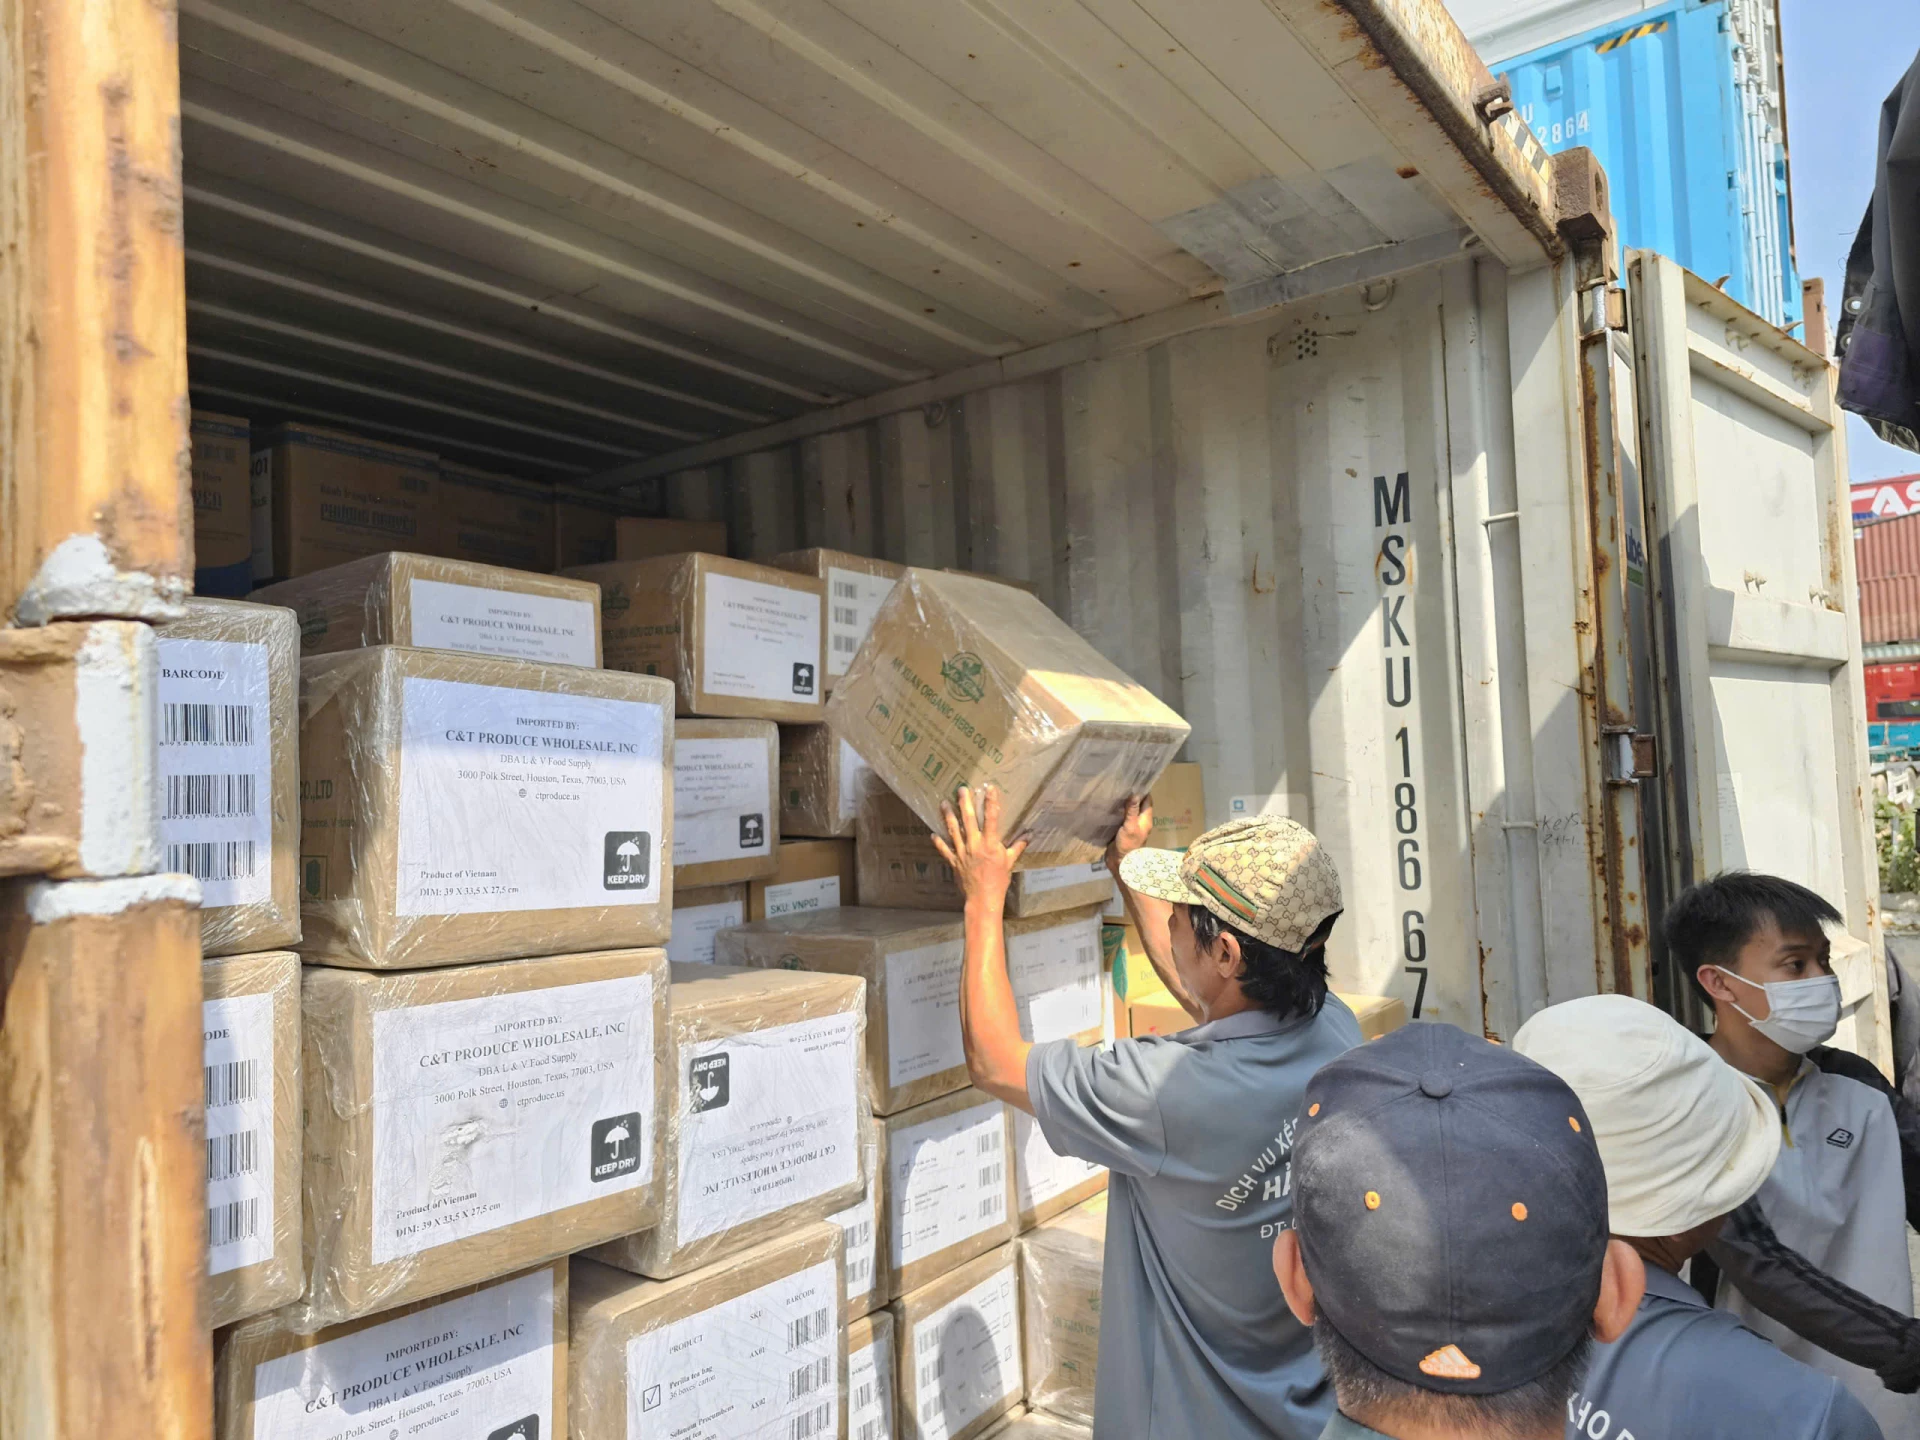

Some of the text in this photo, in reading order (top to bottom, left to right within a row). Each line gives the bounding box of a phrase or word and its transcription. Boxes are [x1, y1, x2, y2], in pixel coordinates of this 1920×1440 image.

[1373, 471, 1413, 708] MSKU
[440, 615, 460, 624] C&T
[463, 617, 504, 629] PRODUCE
[562, 628, 576, 636] INC
[162, 668, 224, 680] BARCODE
[921, 684, 954, 719] ORGANIC
[954, 714, 975, 738] HERB
[516, 717, 579, 730] IMPORTED BY:
[446, 729, 638, 754] C&T PRODUCE WHOLESALE, INC
[500, 754, 592, 769] DBA L & V Food Supply
[458, 771, 478, 780] 3000
[480, 771, 498, 781] Polk
[500, 772, 524, 782] Street,
[526, 773, 559, 784] Houston,
[562, 775, 584, 785] Texas,
[610, 776, 627, 786] USA
[535, 791, 580, 801] ctproduce.us
[420, 869, 497, 879] Product of Vietnam
[607, 874, 646, 884] KEEP DRY
[420, 887, 442, 896] DIM:
[444, 887, 454, 895] 39
[508, 886, 519, 894] cm
[494, 1015, 562, 1034] IMPORTED BY:
[419, 1022, 626, 1068] C&T PRODUCE WHOLESALE, INC
[478, 1051, 578, 1077] DBA L & V Food Supply
[693, 1058, 726, 1072] KEEP DRY
[434, 1092, 456, 1105] 3000
[458, 1088, 477, 1100] Polk
[479, 1085, 505, 1096] Street,
[507, 1078, 543, 1092] Houston,
[545, 1072, 568, 1083] Texas,
[597, 1061, 615, 1072] USA
[517, 1089, 565, 1107] ctproduce.us
[595, 1157, 636, 1177] KEEP DRY
[702, 1183, 719, 1196] INC
[1216, 1174, 1258, 1212] DỊCH
[1252, 1147, 1277, 1174] VỤ
[396, 1192, 477, 1219] Product of Vietnam
[396, 1224, 420, 1238] DIM:
[421, 1221, 432, 1231] 39
[489, 1202, 501, 1211] cm
[786, 1288, 816, 1306] BARCODE
[385, 1330, 459, 1363] IMPORTED BY:
[669, 1335, 704, 1355] PRODUCT
[305, 1324, 525, 1414] C&T PRODUCE WHOLESALE, INC
[669, 1374, 690, 1389] Perilla
[691, 1369, 701, 1380] tea
[368, 1365, 474, 1413] DBA L & V Food Supply
[344, 1367, 512, 1440] Polk Street, Houston, Texas, 77003, USA
[408, 1407, 460, 1436] ctproduce.us
[699, 1405, 734, 1425] Procumbens
